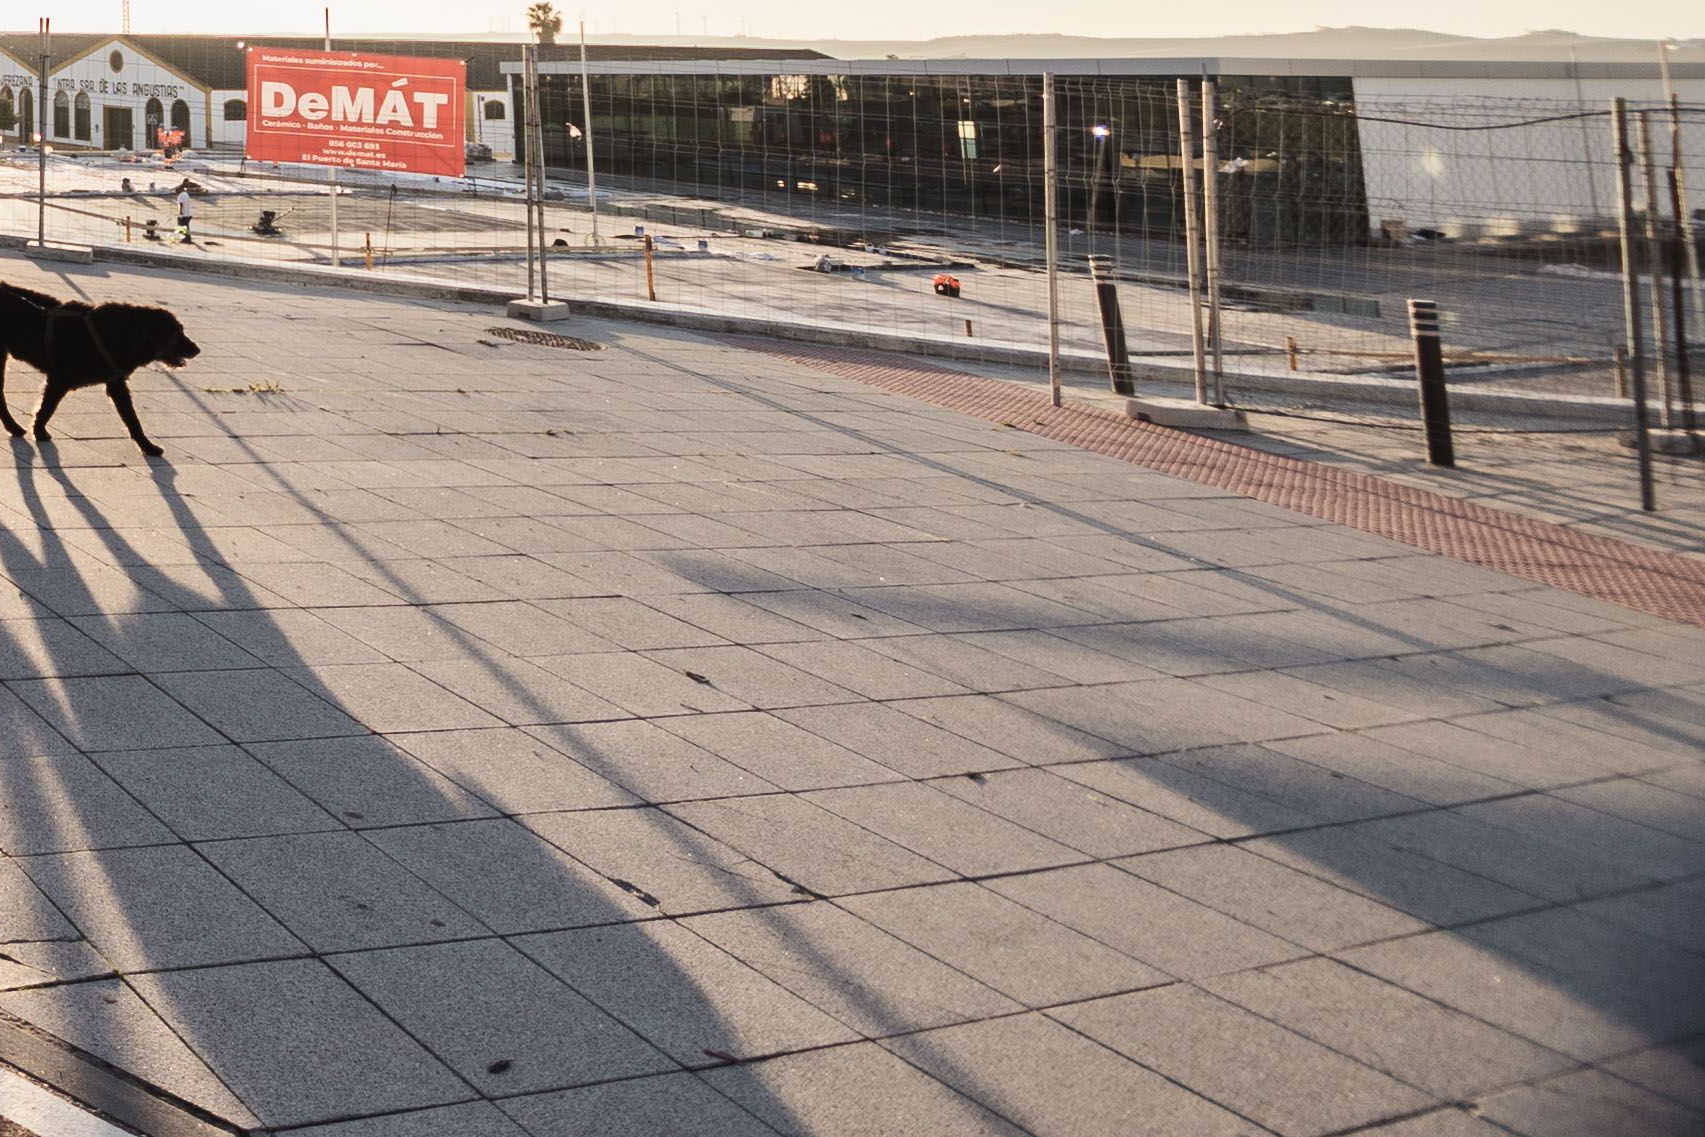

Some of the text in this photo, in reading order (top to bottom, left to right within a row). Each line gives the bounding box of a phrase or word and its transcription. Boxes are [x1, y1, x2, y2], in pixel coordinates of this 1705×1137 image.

[262, 54, 304, 65] Materiales
[305, 57, 363, 68] suministrados
[112, 82, 128, 95] LAS
[261, 77, 449, 129] DeMÁT
[307, 121, 334, 131] Baños
[339, 124, 385, 135] Materiales
[312, 155, 341, 165] Puerto
[343, 157, 355, 165] de
[356, 158, 381, 168] Santa
